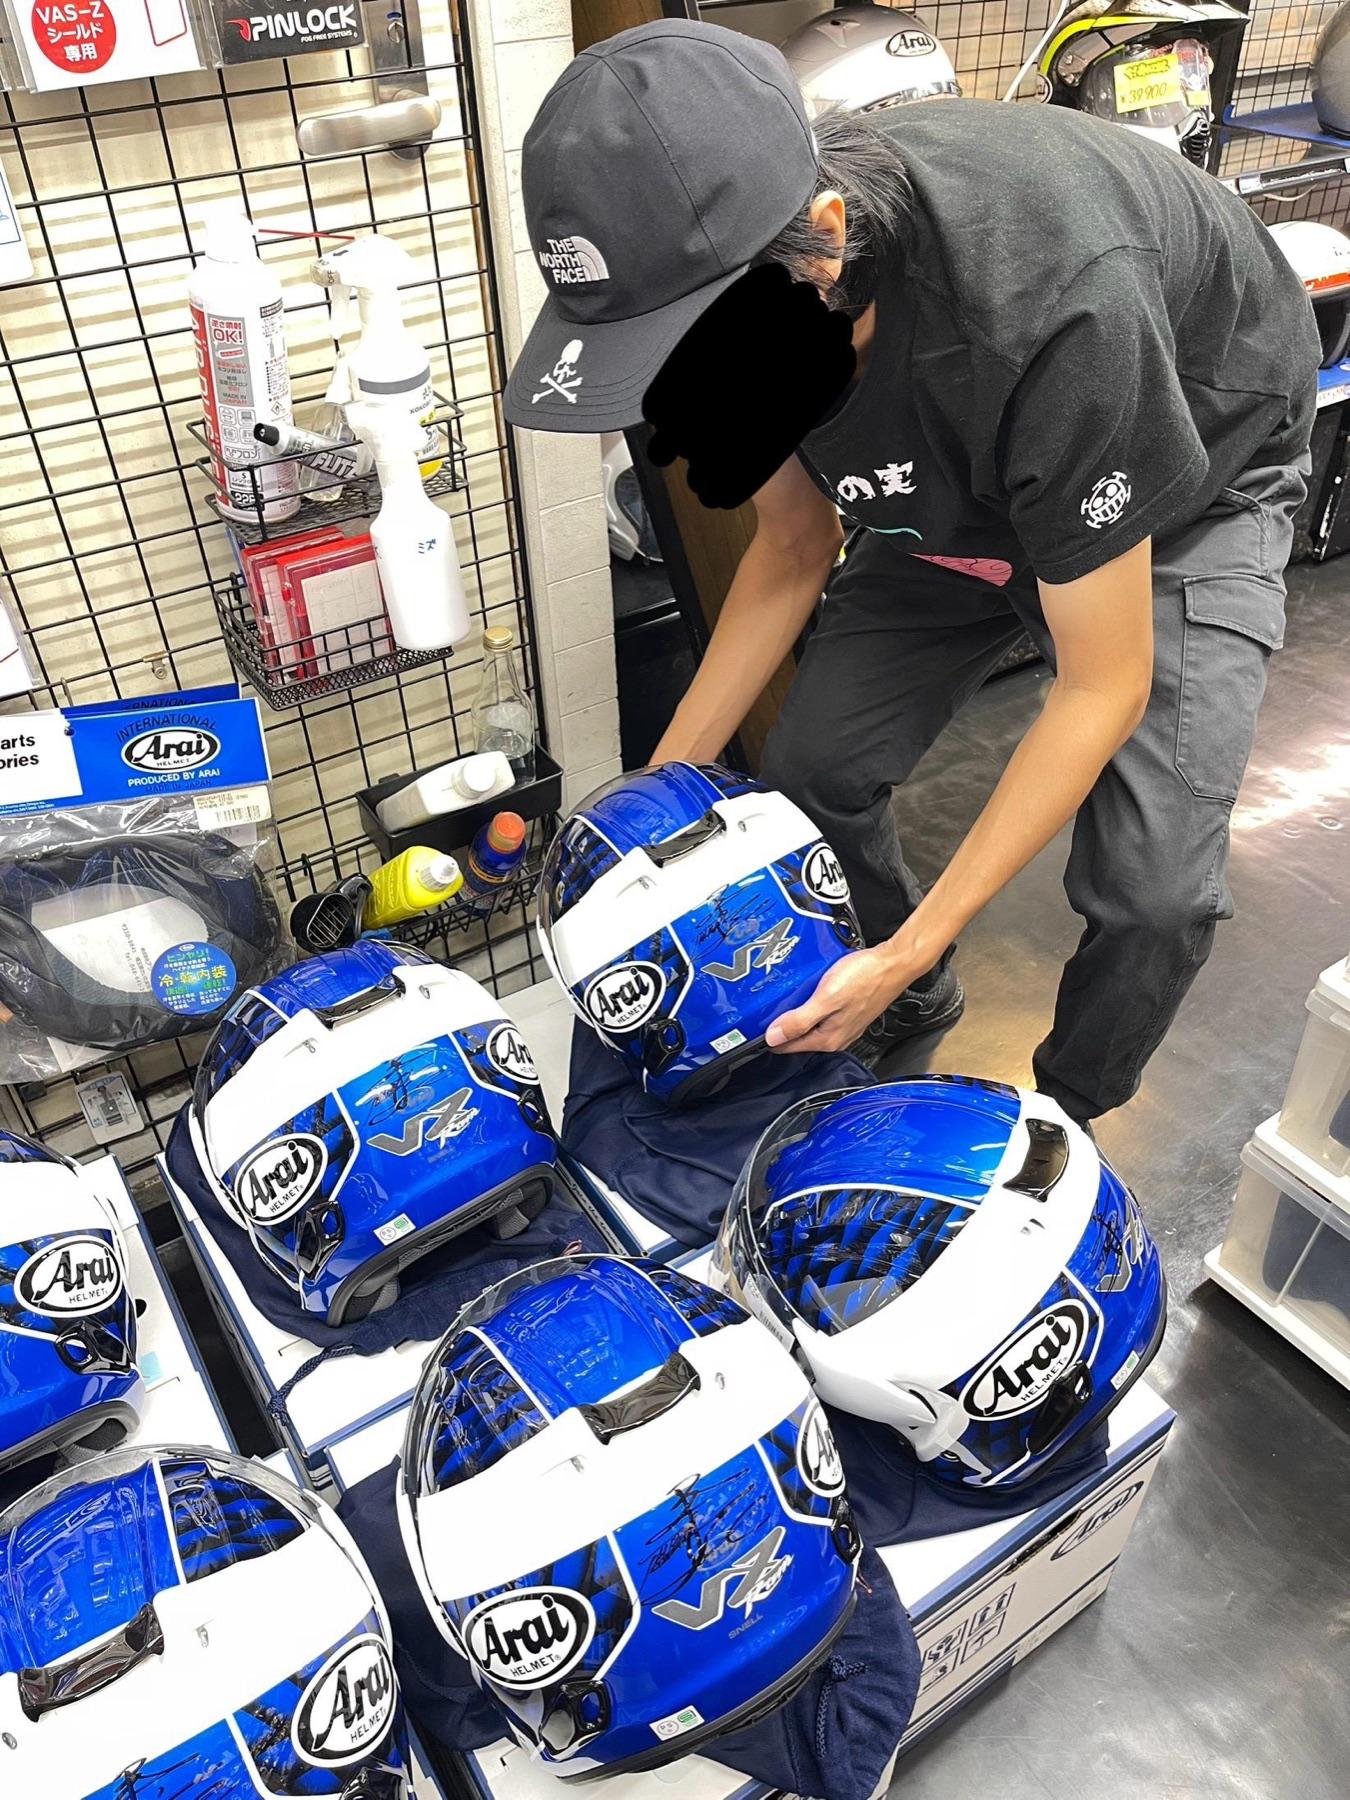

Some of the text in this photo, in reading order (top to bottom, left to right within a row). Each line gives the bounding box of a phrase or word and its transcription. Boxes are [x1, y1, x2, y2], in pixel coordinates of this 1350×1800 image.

[35, 1, 104, 24] VAS-Z
[250, 3, 357, 41] PINLOCK
[47, 22, 103, 44] シールド
[328, 30, 353, 40] SYSTEMS
[893, 34, 931, 53] Arai
[64, 42, 98, 62] 専用
[546, 238, 576, 253] THE
[539, 251, 582, 268] NORTH
[552, 267, 586, 284] FACE
[213, 328, 243, 343] OK!
[837, 461, 917, 502] の実
[116, 713, 217, 743] INTERNATIONAL
[132, 733, 207, 763] Arai
[156, 758, 190, 767] HELMET
[128, 768, 220, 787] PRODUCED BY ARAI
[145, 784, 167, 793] MADE
[186, 780, 212, 790] JAPAN
[596, 967, 650, 1023] Arai
[616, 1004, 644, 1024] HELMET
[248, 1141, 309, 1217] Arai
[269, 1184, 301, 1213] HELMET
[33, 1247, 115, 1301] Arai
[68, 1287, 105, 1304] HELMET
[983, 1315, 1072, 1416] Arai
[1020, 1360, 1064, 1401] HELMET
[482, 1595, 570, 1670] Arai
[728, 1615, 764, 1640] SNELL
[510, 1653, 556, 1677] HELMET
[312, 1643, 390, 1750] Arai
[350, 1706, 385, 1743] HELMET
